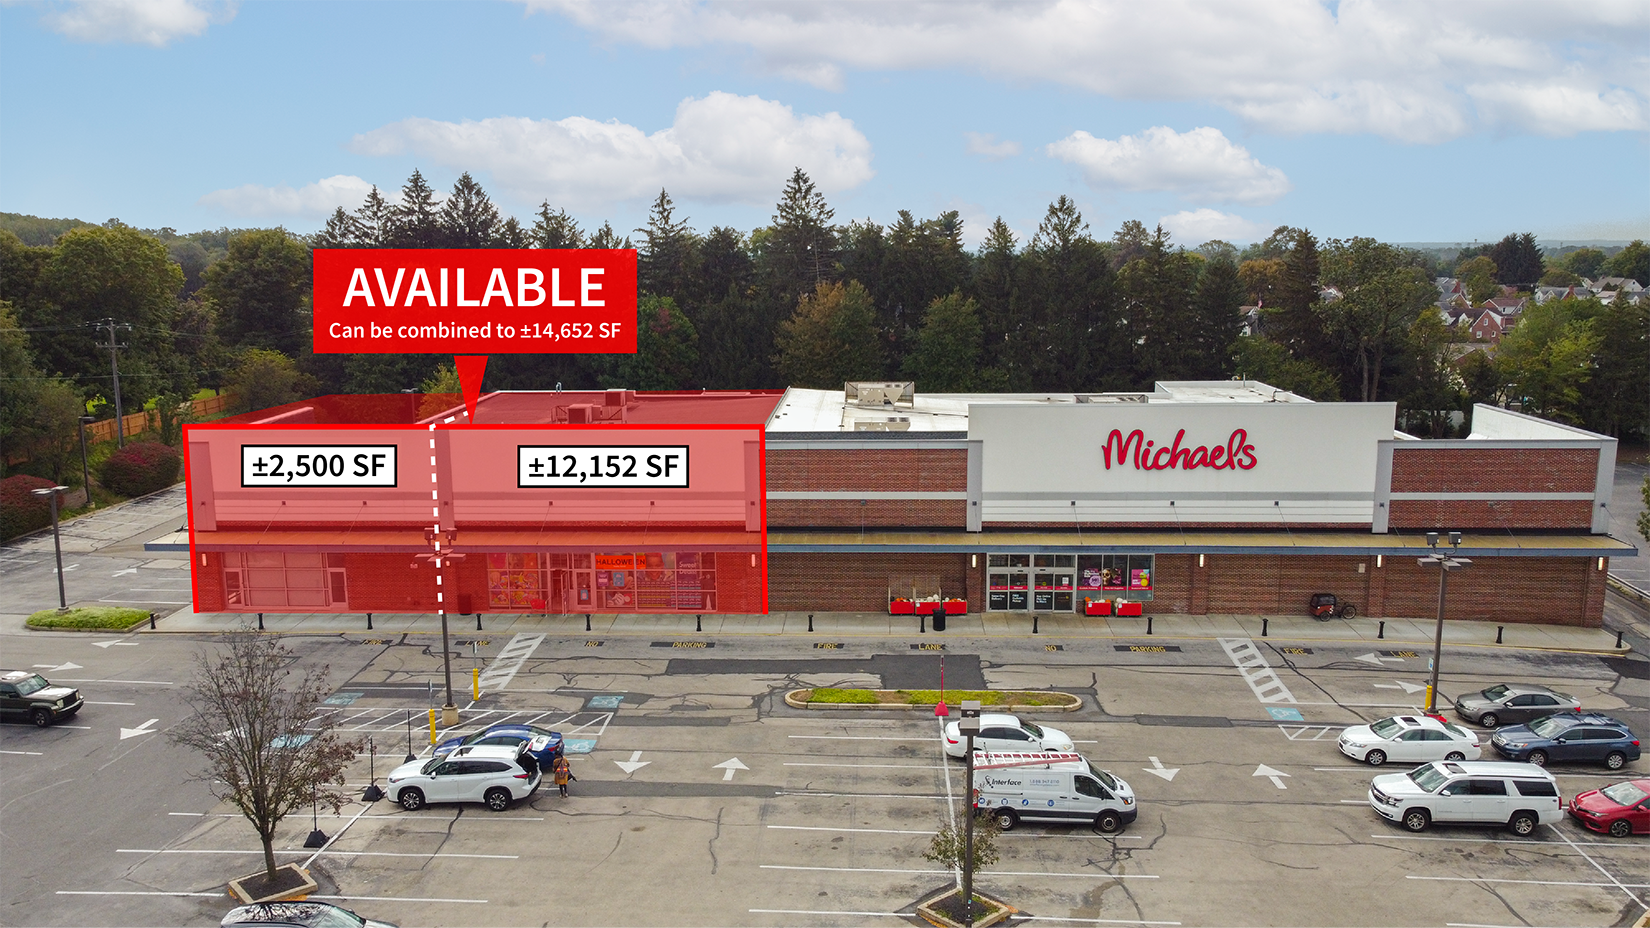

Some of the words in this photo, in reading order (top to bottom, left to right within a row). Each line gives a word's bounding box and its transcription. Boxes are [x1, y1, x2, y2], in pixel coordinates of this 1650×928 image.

[1101, 428, 1258, 470] Michaels
[596, 558, 646, 566] HALLOWEEN
[672, 641, 708, 649] PARKING
[1129, 645, 1166, 653] PARKING
[1390, 651, 1420, 659] LANE
[991, 778, 1022, 786] Interface
